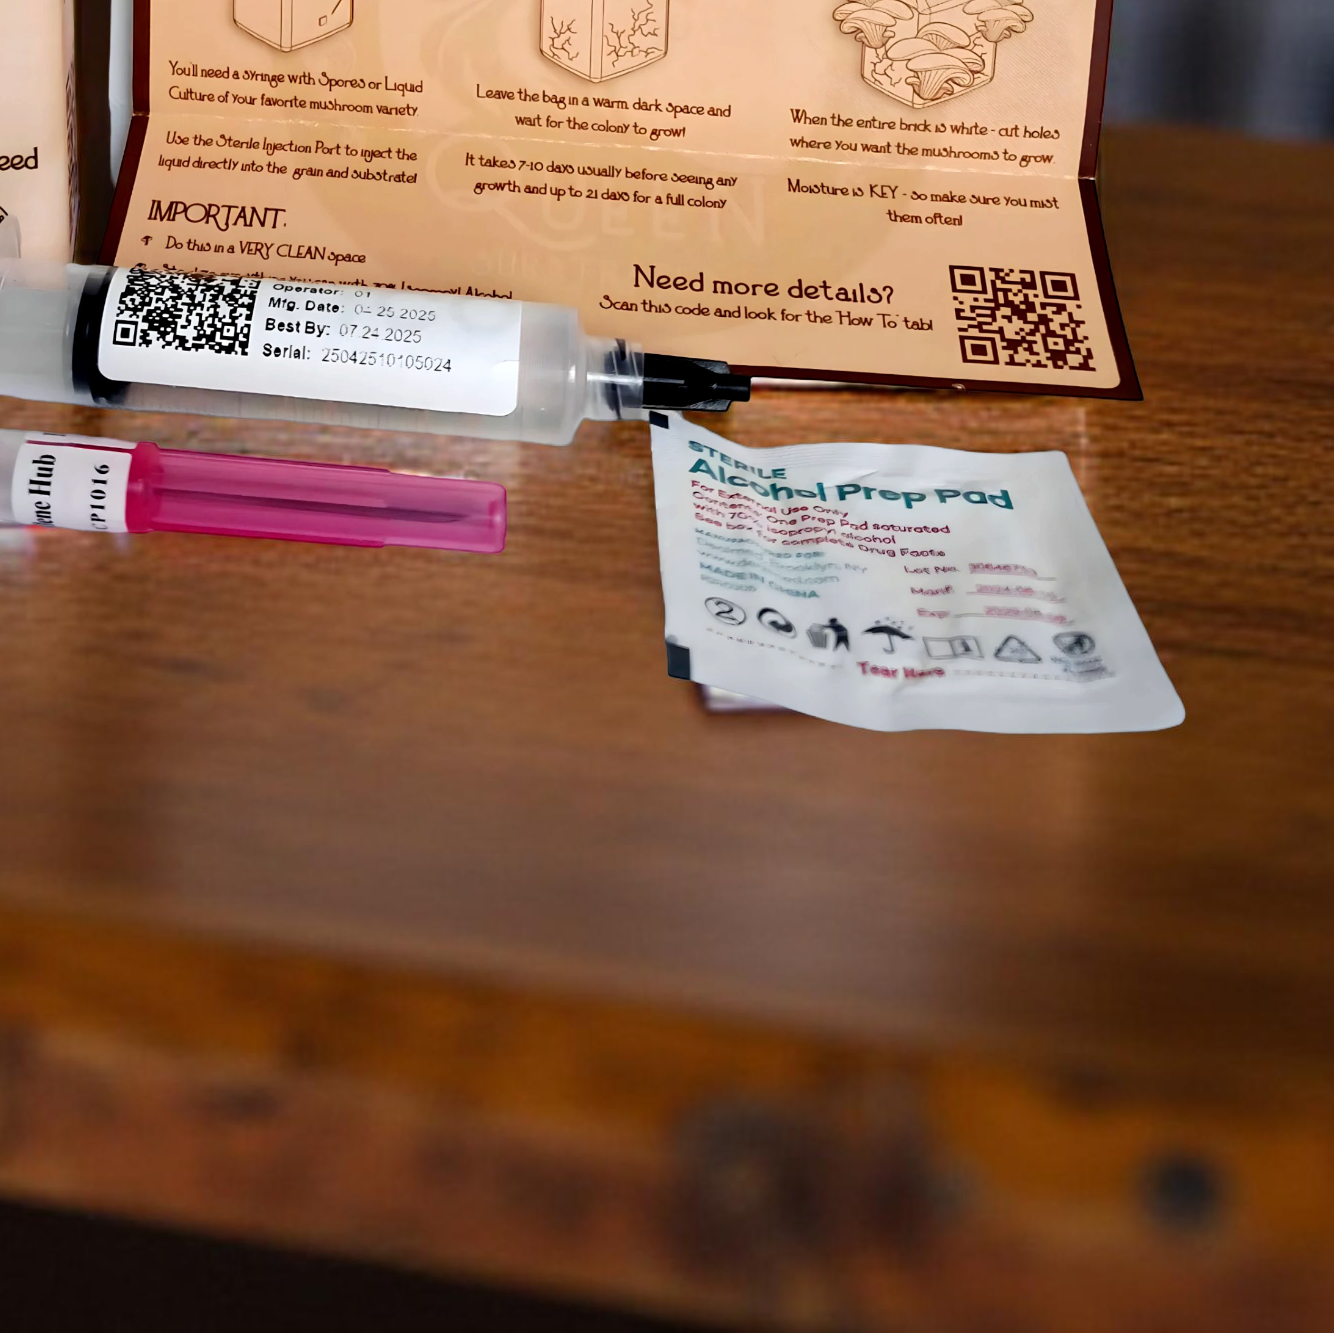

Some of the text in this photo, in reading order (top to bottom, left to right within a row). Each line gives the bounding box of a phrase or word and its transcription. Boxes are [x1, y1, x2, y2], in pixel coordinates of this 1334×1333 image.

[200, 66, 230, 80] need
[231, 69, 241, 80] a
[241, 69, 286, 89] syringe
[286, 71, 316, 86] with
[317, 71, 367, 93] Spores
[367, 81, 383, 91] or
[384, 75, 424, 98] Liquid
[168, 85, 216, 103] Culture
[216, 90, 231, 104] of
[231, 93, 258, 106] your
[260, 92, 308, 109] favorite
[309, 98, 374, 114] mushroom
[476, 83, 732, 119] Leave the bag in a warm dark space and
[514, 113, 543, 128] wait
[545, 114, 565, 129] for
[565, 116, 589, 131] the
[590, 119, 631, 134] colony
[631, 121, 648, 136] to
[789, 108, 1061, 140] When the entire brick is white cut holes
[165, 130, 418, 164] Use the Sterile Injection Port to inject the
[788, 135, 833, 150] where
[834, 139, 858, 152] you
[860, 141, 892, 154] want
[894, 141, 919, 156] the
[920, 145, 1000, 161] mushrooms
[1001, 148, 1018, 162] to
[464, 151, 739, 191] It takes 7-10 days usually before seeing any
[473, 179, 728, 209] growth and up to 21 days for a full colony
[786, 177, 1060, 210] Moisture is KEY so make sure you mist
[164, 235, 367, 267] Do this in a VERY CLEAN space
[273, 284, 371, 298] Operator: 01
[632, 263, 705, 293] Need
[712, 279, 781, 297] more
[786, 278, 895, 305] details?
[268, 296, 344, 314] Mfg. Date:
[265, 318, 301, 333] Best
[305, 321, 330, 338] By:
[262, 343, 311, 360] Serial:
[28, 454, 56, 496] Hub
[688, 440, 787, 479] STERILE
[689, 458, 1014, 510] Alcohol Prep Pad
